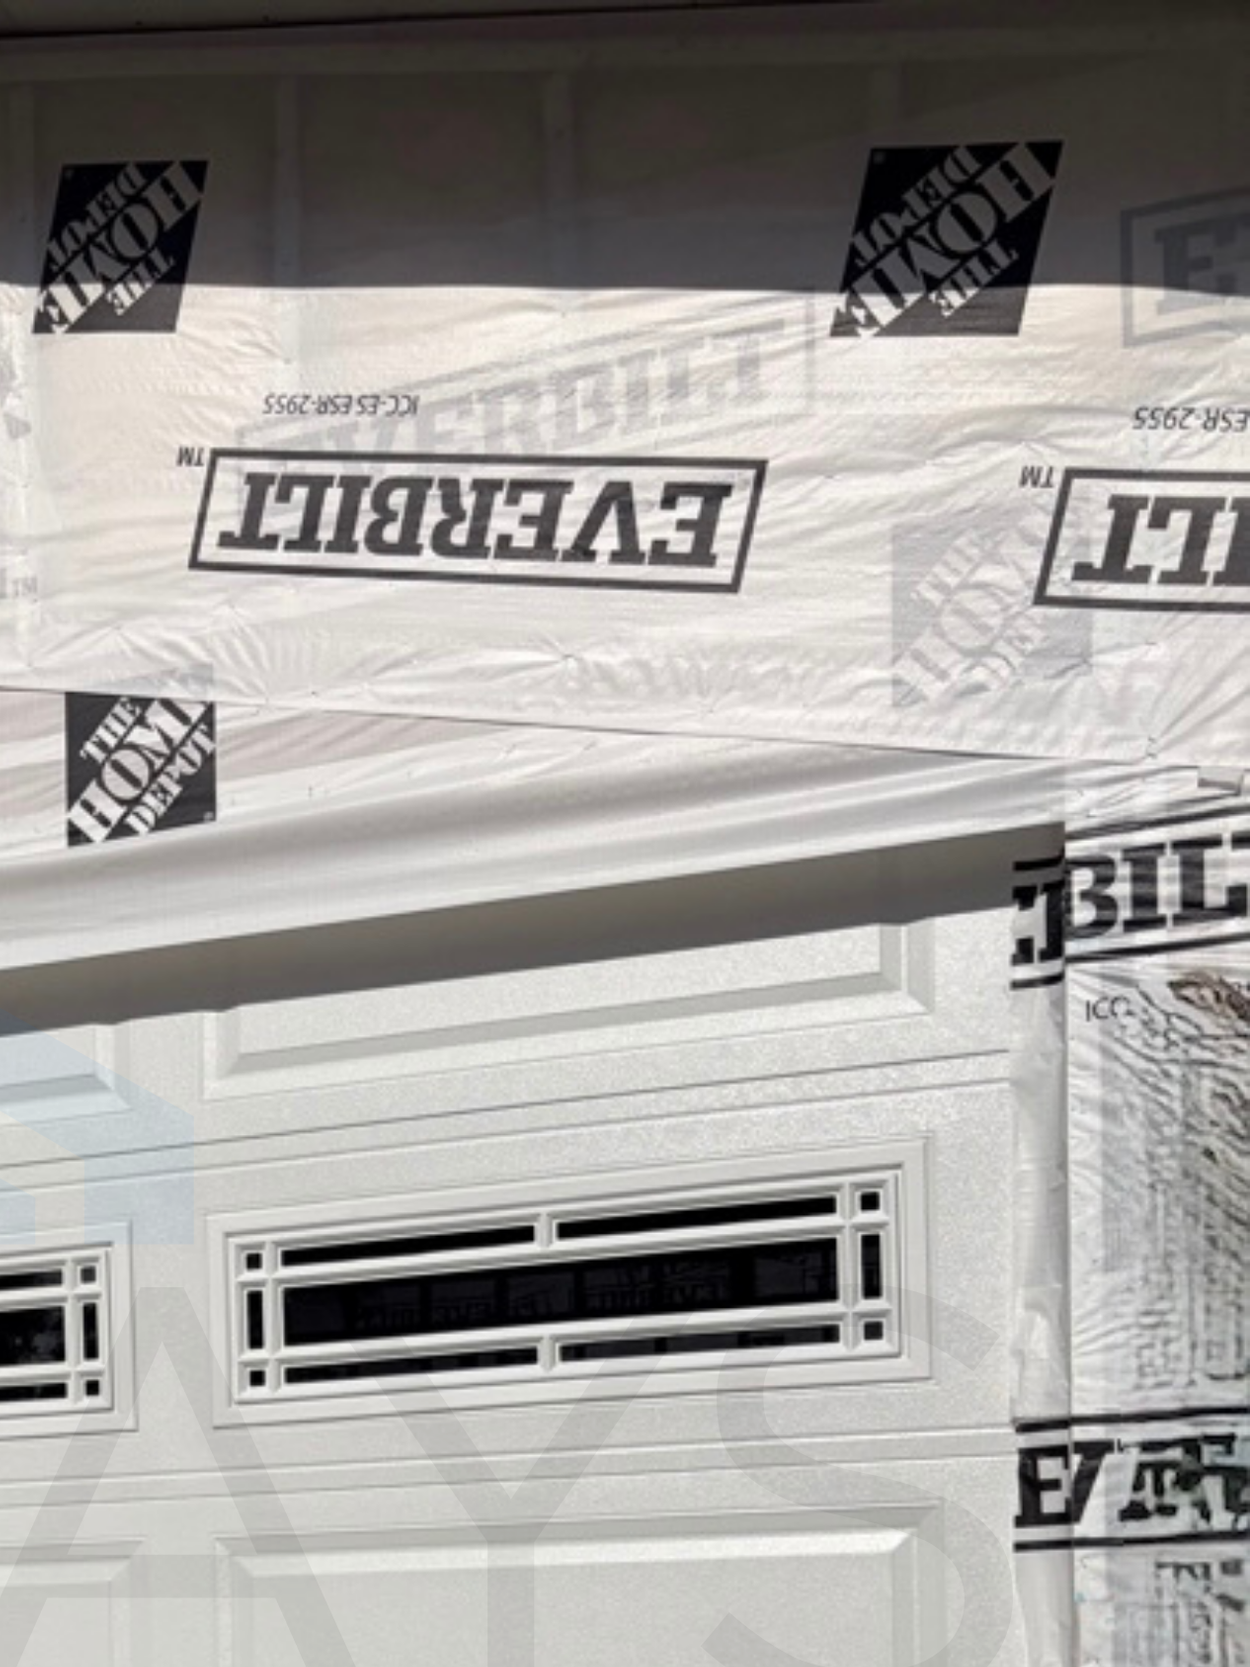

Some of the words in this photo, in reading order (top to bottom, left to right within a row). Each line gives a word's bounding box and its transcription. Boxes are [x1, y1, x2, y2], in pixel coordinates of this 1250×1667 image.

[37, 161, 203, 333] HOME
[49, 161, 148, 271] DEPOT
[835, 142, 1056, 337] HOME
[852, 146, 982, 268] DEPOT
[106, 248, 175, 315] THE
[928, 240, 1019, 317] THE
[217, 472, 733, 567] EVERBILT
[80, 697, 141, 764] THE
[124, 724, 216, 836] DEPOT
